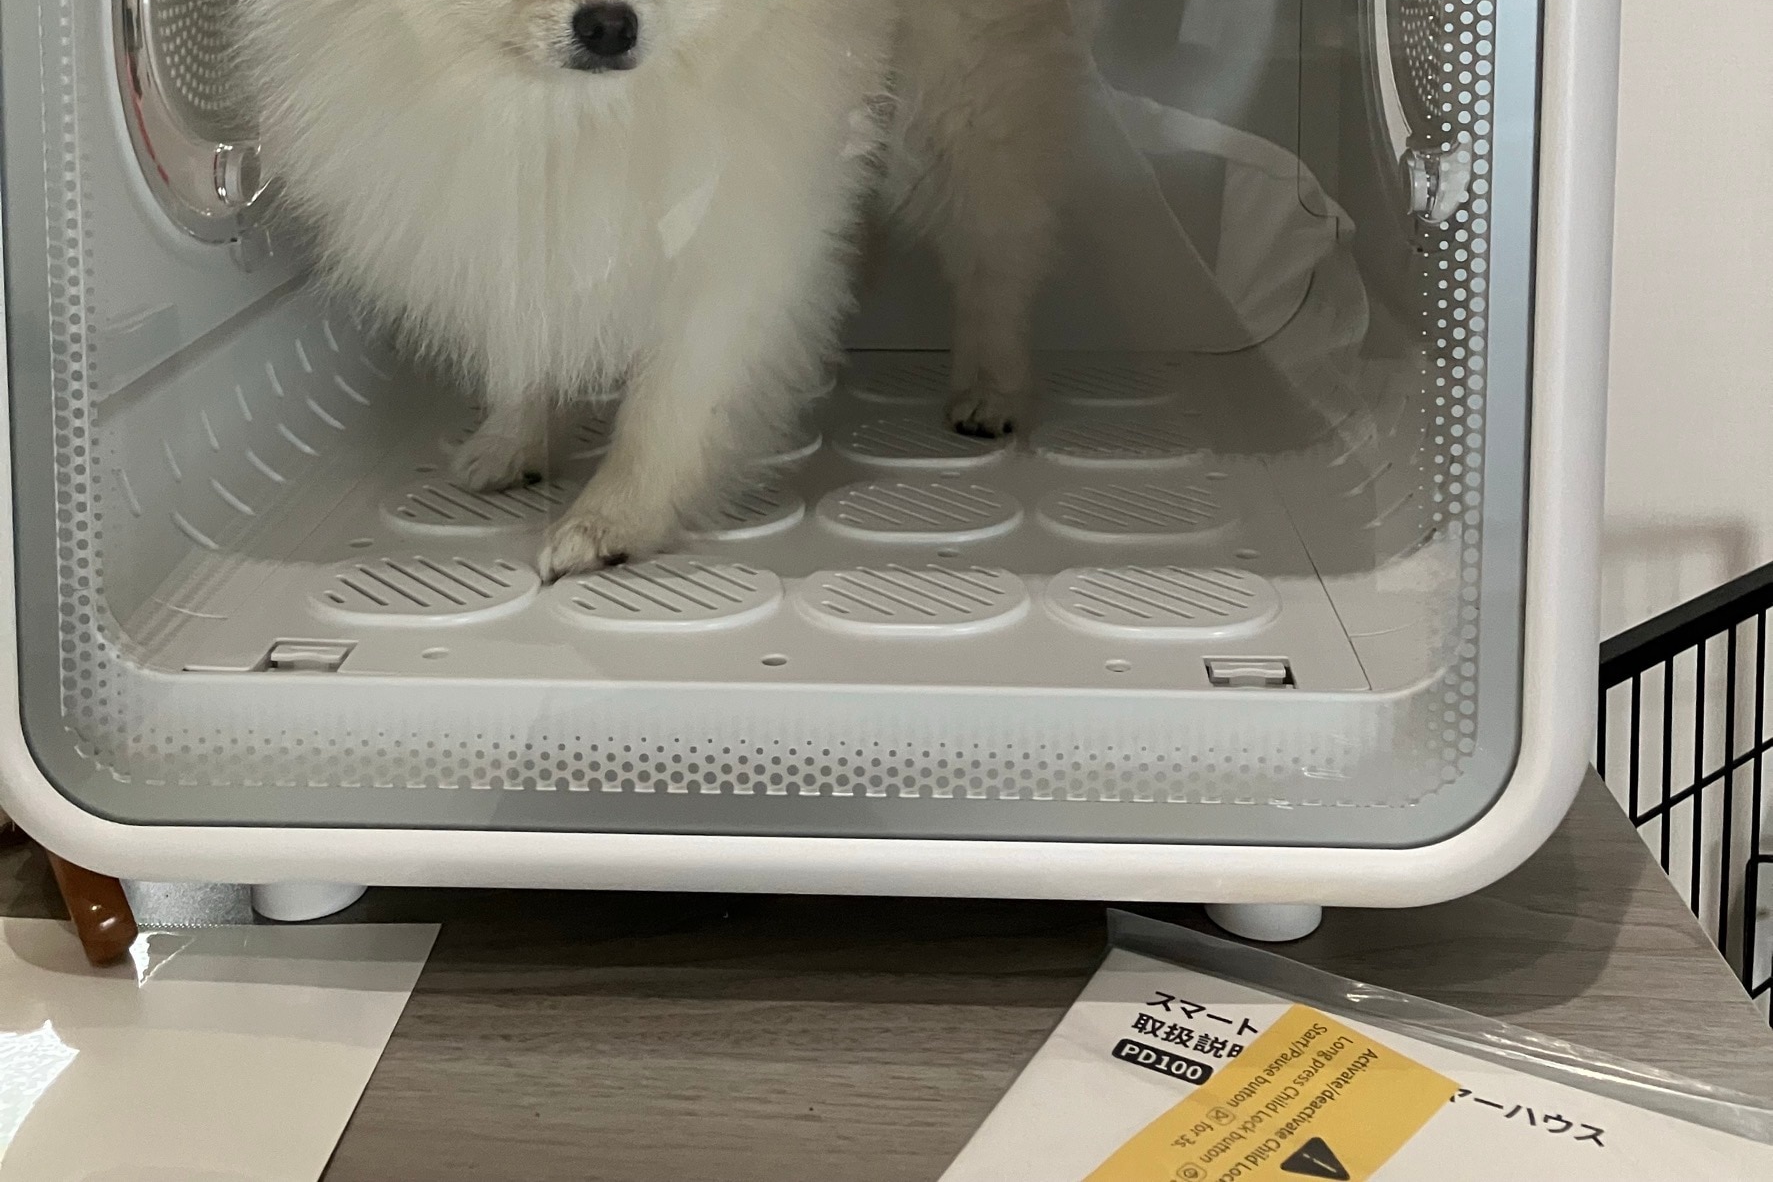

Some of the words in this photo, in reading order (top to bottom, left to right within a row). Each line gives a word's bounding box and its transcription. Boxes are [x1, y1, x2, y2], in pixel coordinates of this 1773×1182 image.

[1146, 991, 1258, 1035] スマート
[1120, 1043, 1203, 1080] PD100
[1263, 1022, 1328, 1077] Start/Pause
[1317, 1036, 1354, 1062] Long
[1293, 1058, 1325, 1087] press
[1226, 1075, 1272, 1108] button
[1265, 1086, 1300, 1114] Child
[1274, 1048, 1379, 1141] Activate/deactivate
[1189, 1121, 1214, 1137] for
[1238, 1109, 1272, 1134] Lock
[1170, 1134, 1196, 1148] 3s.
[1199, 1131, 1247, 1163] button
[1244, 1138, 1281, 1167] Child
[1216, 1162, 1252, 1182] Loc
